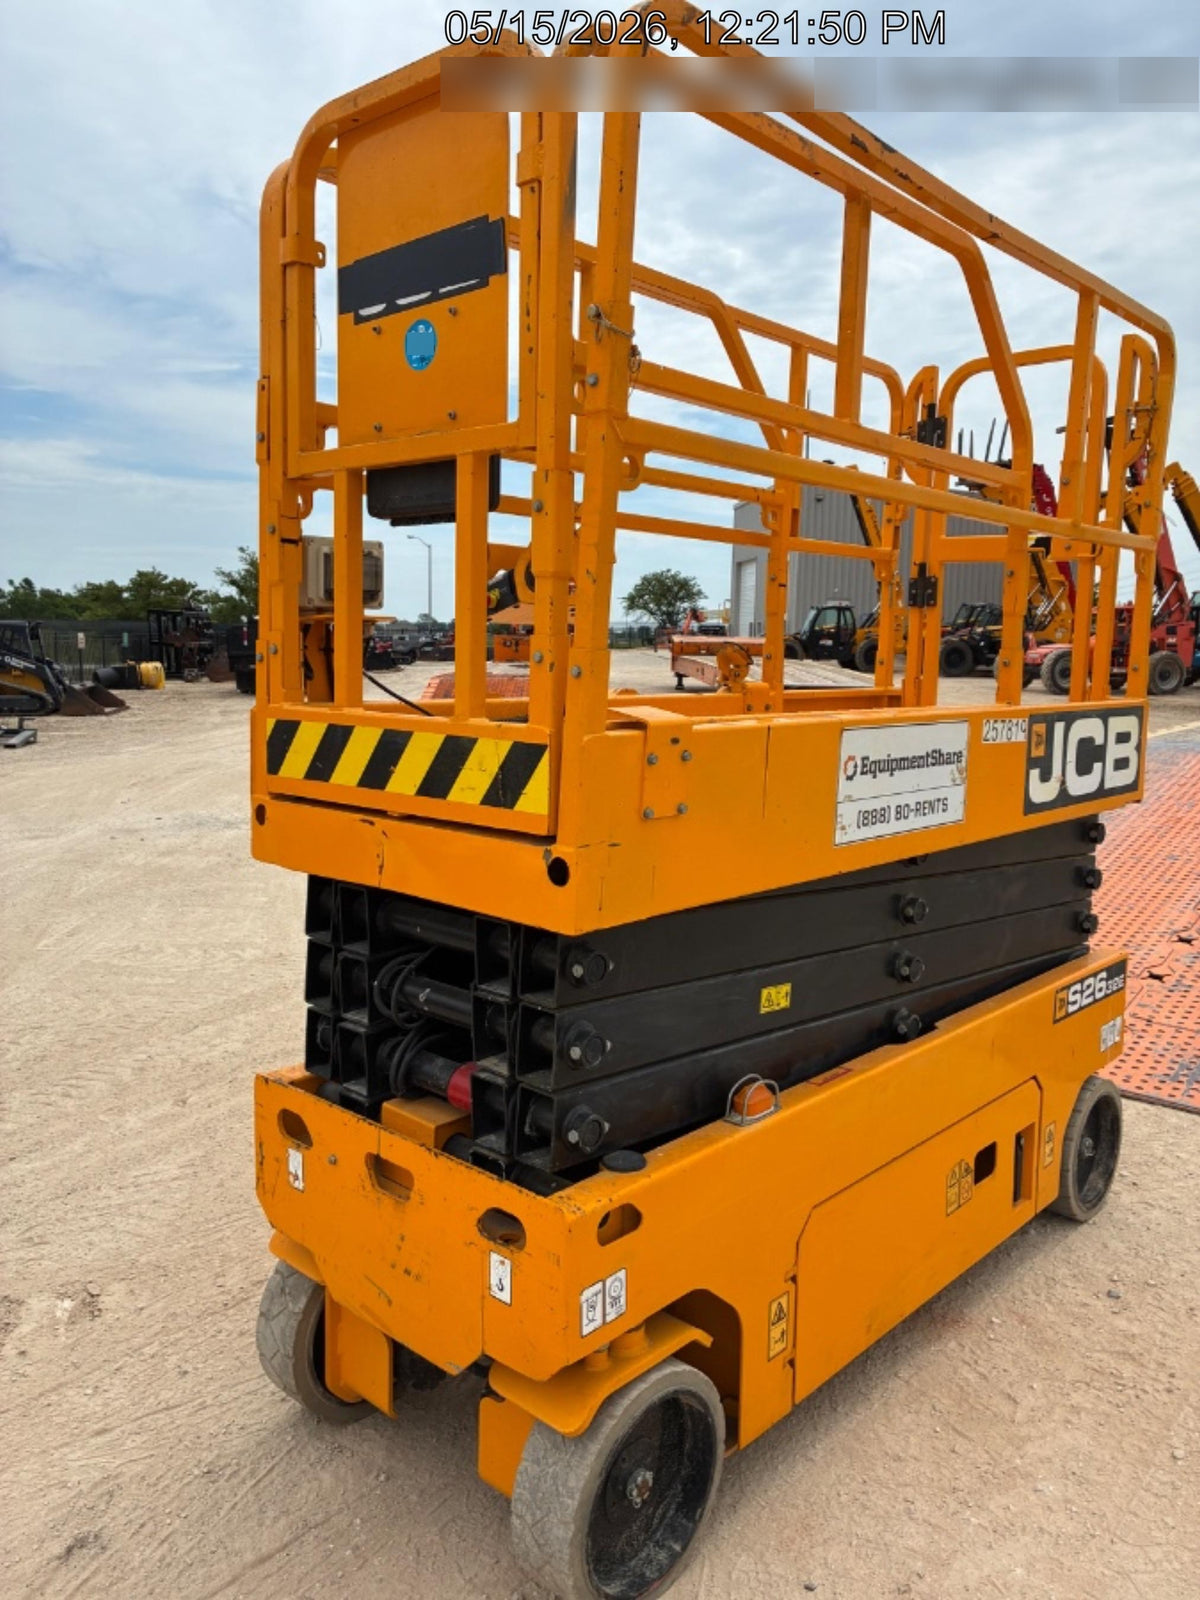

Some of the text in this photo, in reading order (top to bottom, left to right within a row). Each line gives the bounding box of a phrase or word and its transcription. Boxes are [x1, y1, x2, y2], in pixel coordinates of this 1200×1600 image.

[859, 748, 963, 779] EquipmentShare
[1028, 715, 1140, 804] JCB
[856, 805, 892, 829] (888)
